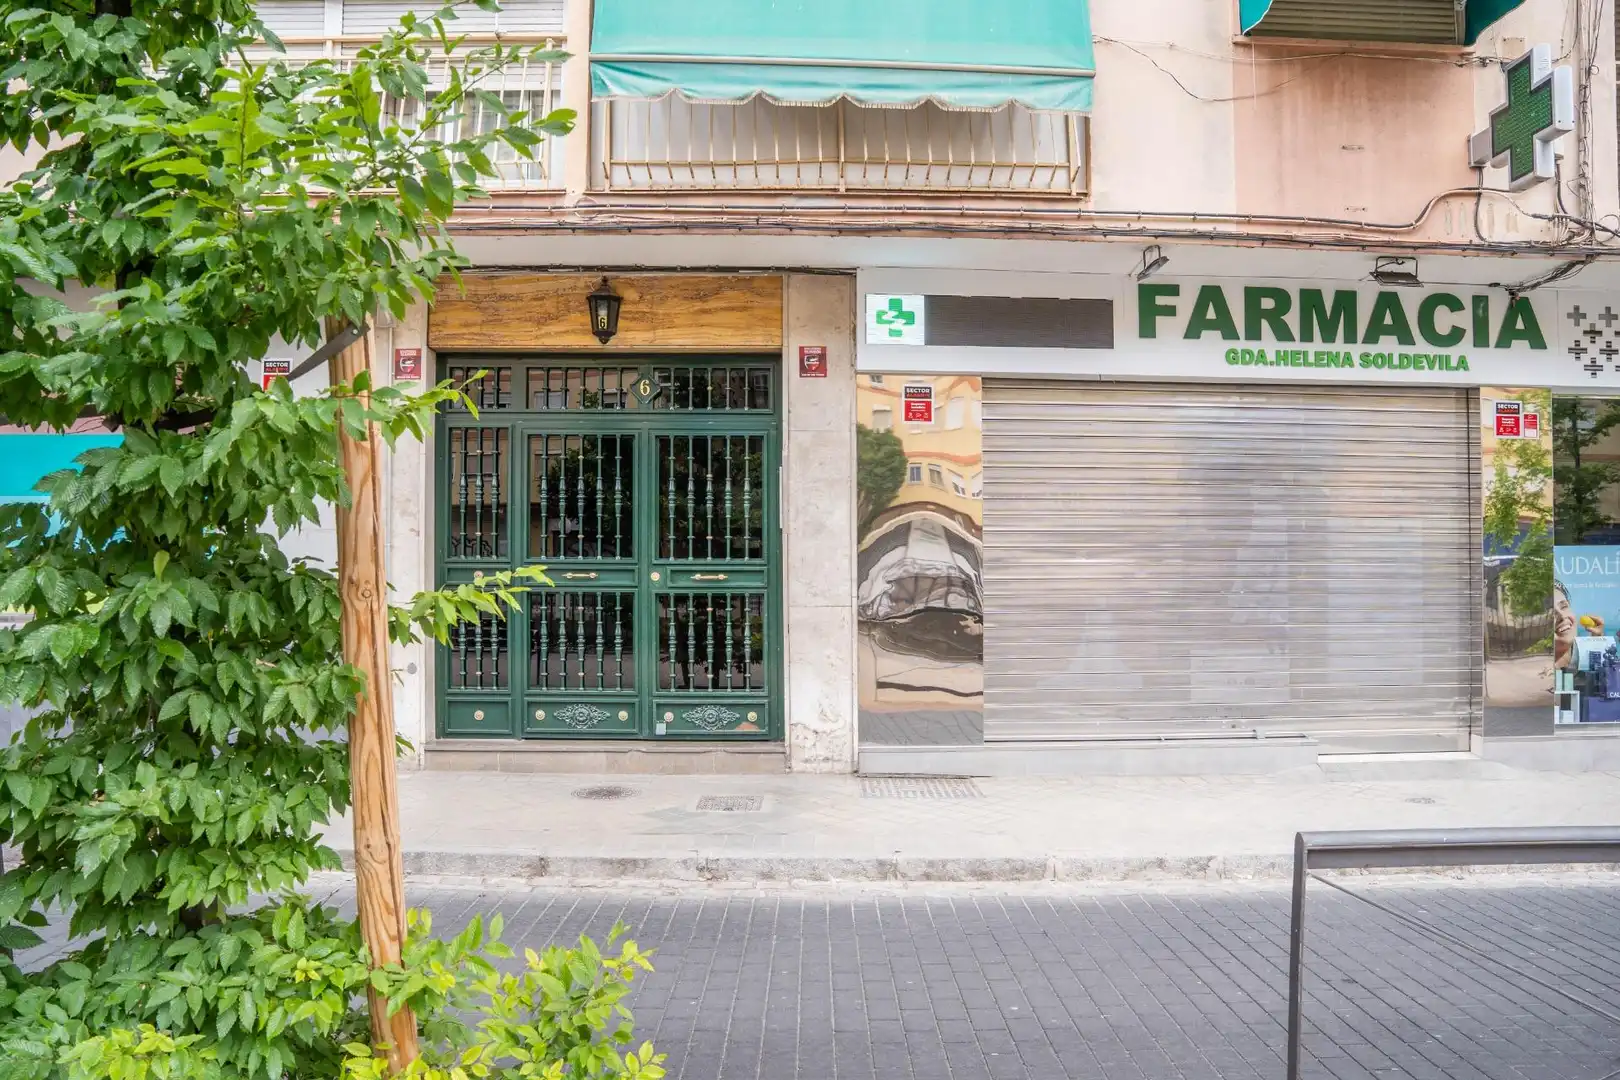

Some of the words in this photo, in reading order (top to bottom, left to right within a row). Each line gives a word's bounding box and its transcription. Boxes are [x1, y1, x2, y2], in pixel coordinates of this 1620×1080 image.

[600, 317, 606, 329] 6
[1137, 283, 1548, 350] FARMACIA
[1225, 349, 1354, 369] GDA.HELENA
[1359, 352, 1470, 371] SOLDEVILA
[639, 379, 651, 396] 6
